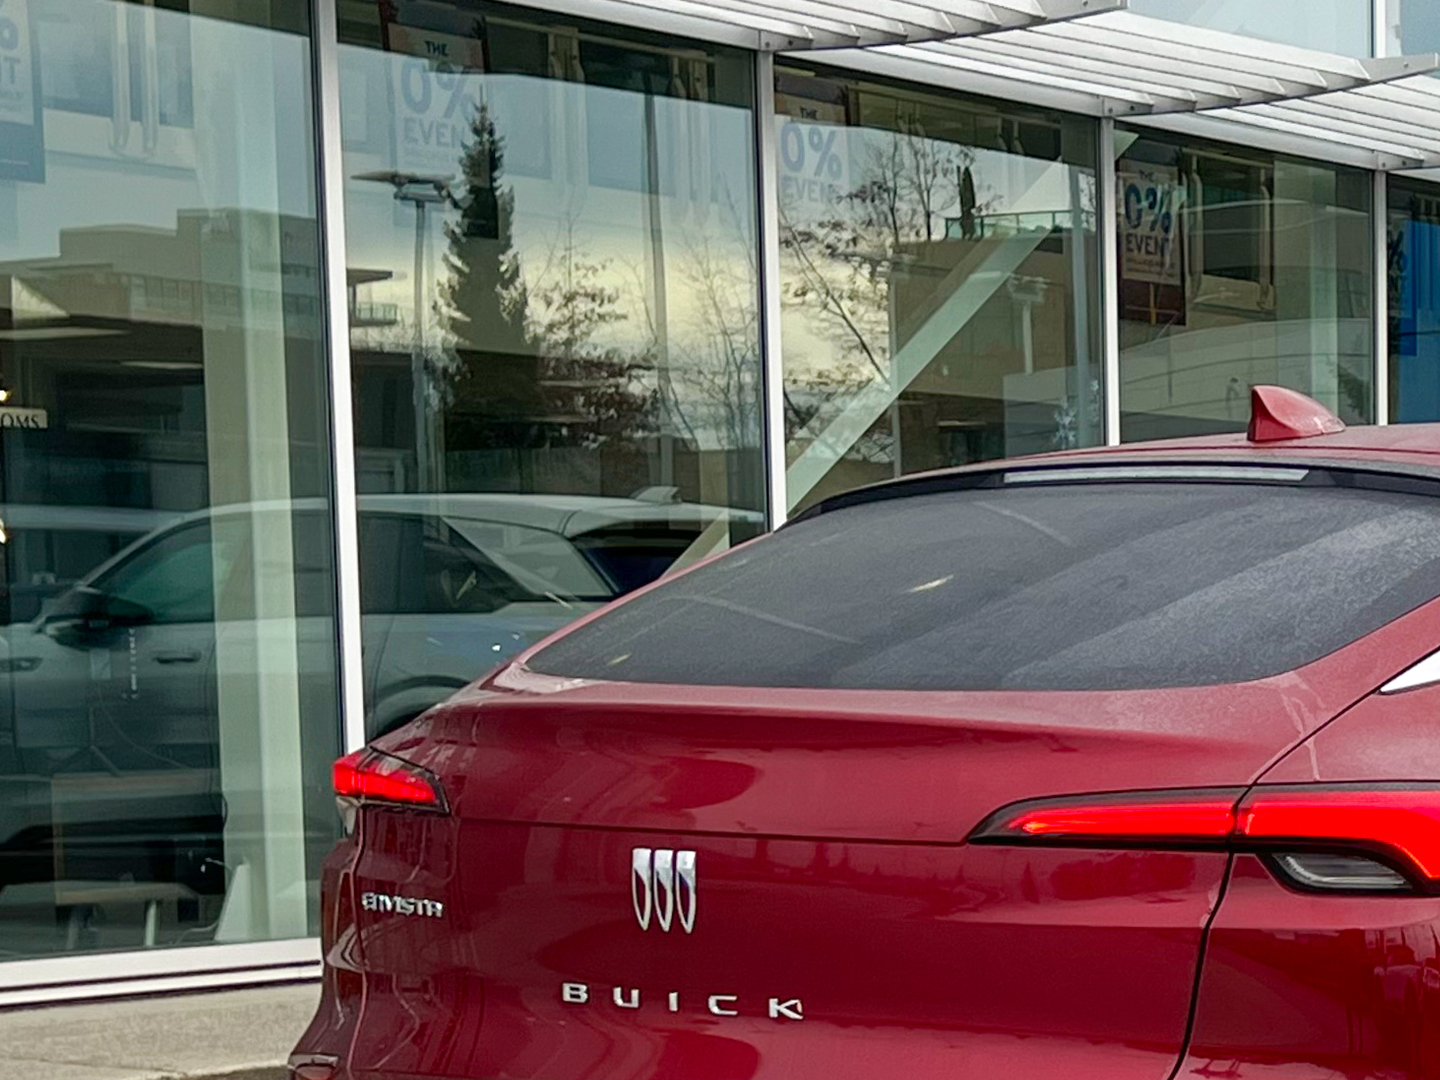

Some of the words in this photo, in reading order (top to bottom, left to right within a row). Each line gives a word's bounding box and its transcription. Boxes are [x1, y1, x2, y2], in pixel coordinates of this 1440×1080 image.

[425, 40, 449, 57] THE
[401, 60, 477, 119] 0%
[404, 117, 469, 150] EVEN
[781, 121, 843, 181] 0%
[1125, 183, 1172, 234] 0%
[0, 413, 40, 429] OMS
[562, 982, 804, 1020] BUICK
